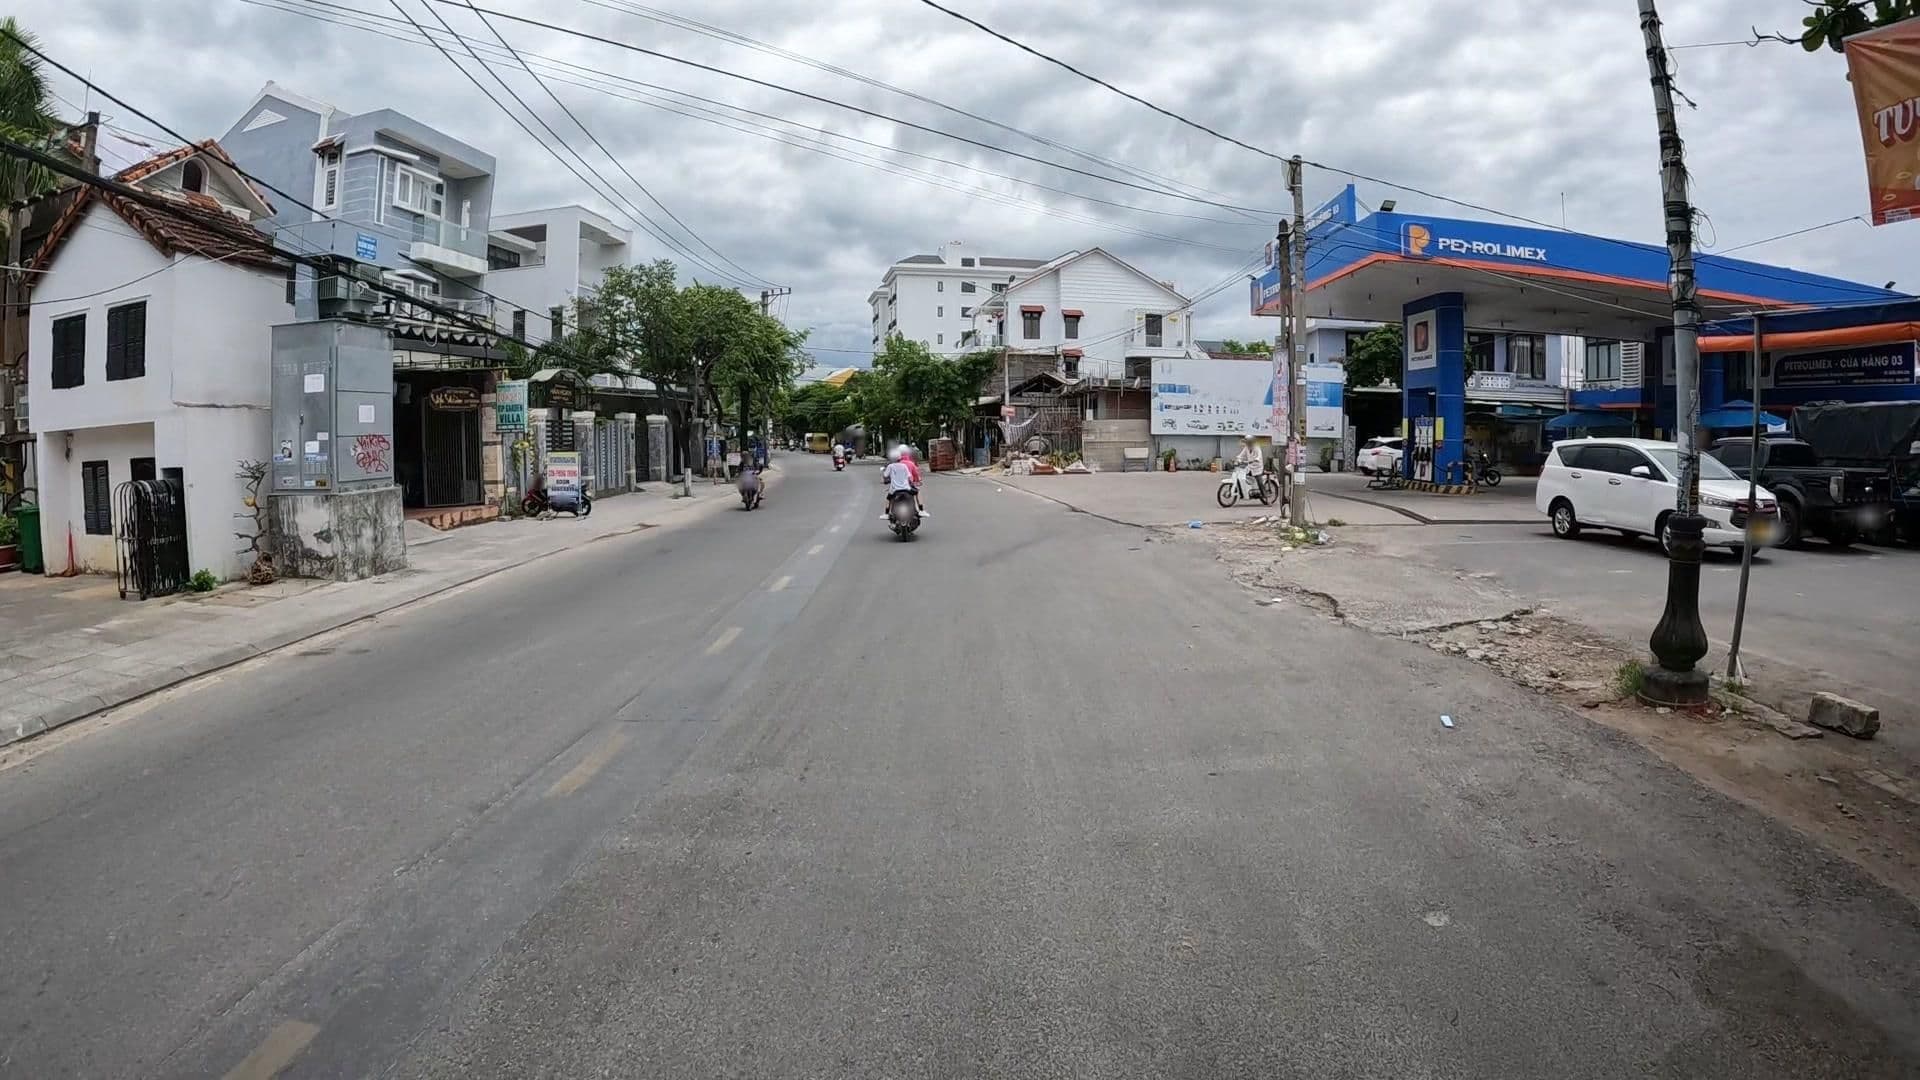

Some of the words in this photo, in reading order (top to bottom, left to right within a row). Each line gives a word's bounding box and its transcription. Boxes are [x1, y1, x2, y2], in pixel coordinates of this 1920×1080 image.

[1438, 237, 1547, 261] PETROLIMEX
[1784, 358, 1833, 371] PETROLIMEX
[1891, 355, 1903, 366] 03
[500, 413, 521, 423] VILLA
